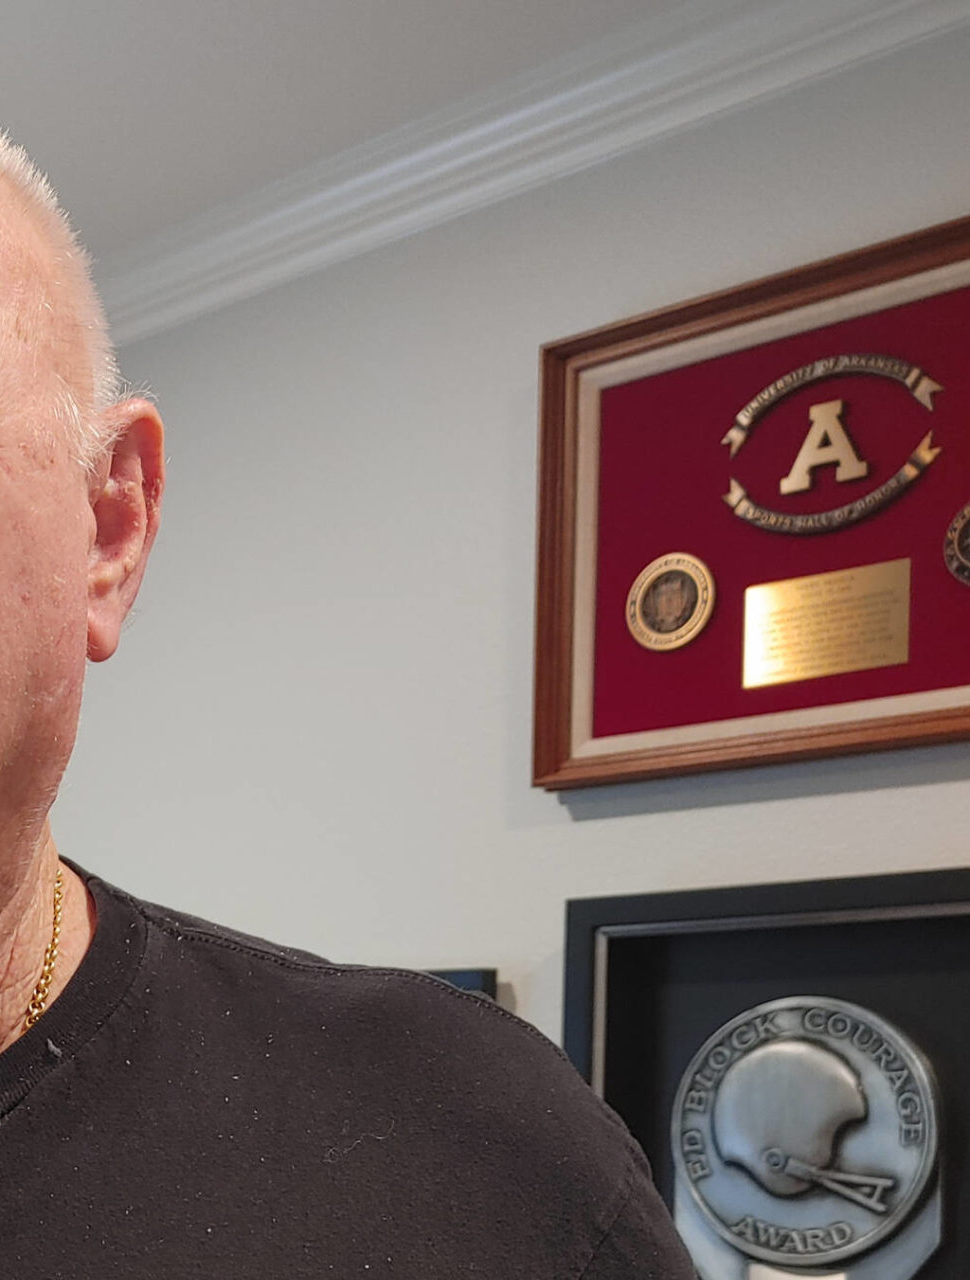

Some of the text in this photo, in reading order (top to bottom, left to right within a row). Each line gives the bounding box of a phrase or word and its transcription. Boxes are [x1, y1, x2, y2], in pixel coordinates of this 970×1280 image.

[843, 355, 908, 376] ARKANSAS
[780, 400, 867, 495] A
[746, 503, 792, 528] SPORTS
[797, 514, 828, 528] HALL
[834, 507, 850, 522] OF
[682, 1006, 925, 1182] ED BLOCK COURAGE
[732, 1214, 854, 1254] AWARD
